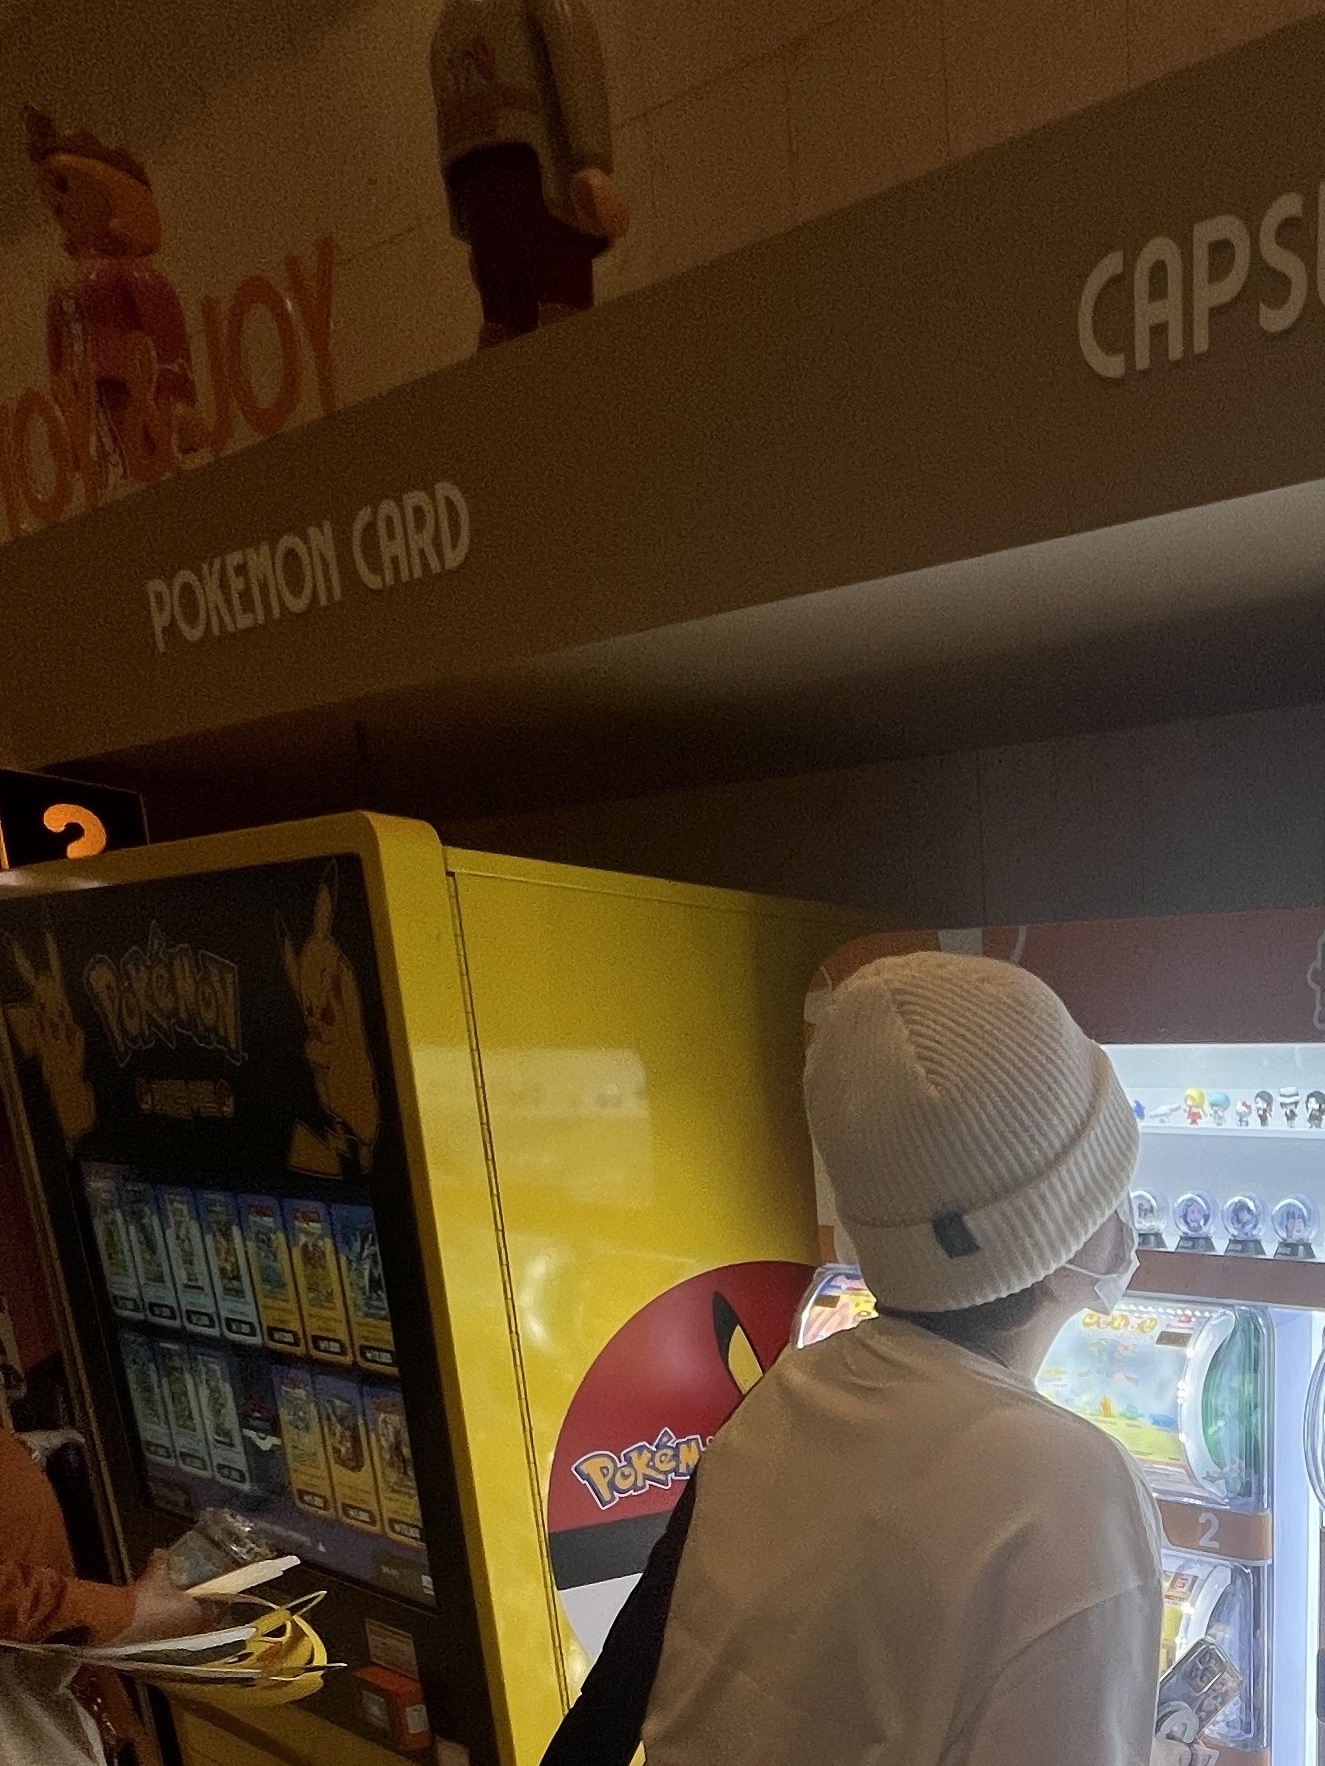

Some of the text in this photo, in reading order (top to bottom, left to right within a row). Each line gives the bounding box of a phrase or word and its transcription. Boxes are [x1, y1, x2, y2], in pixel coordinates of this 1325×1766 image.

[176, 236, 338, 458] JOY
[146, 482, 471, 653] POKEMON CARD
[1199, 1512, 1219, 1549] 2
